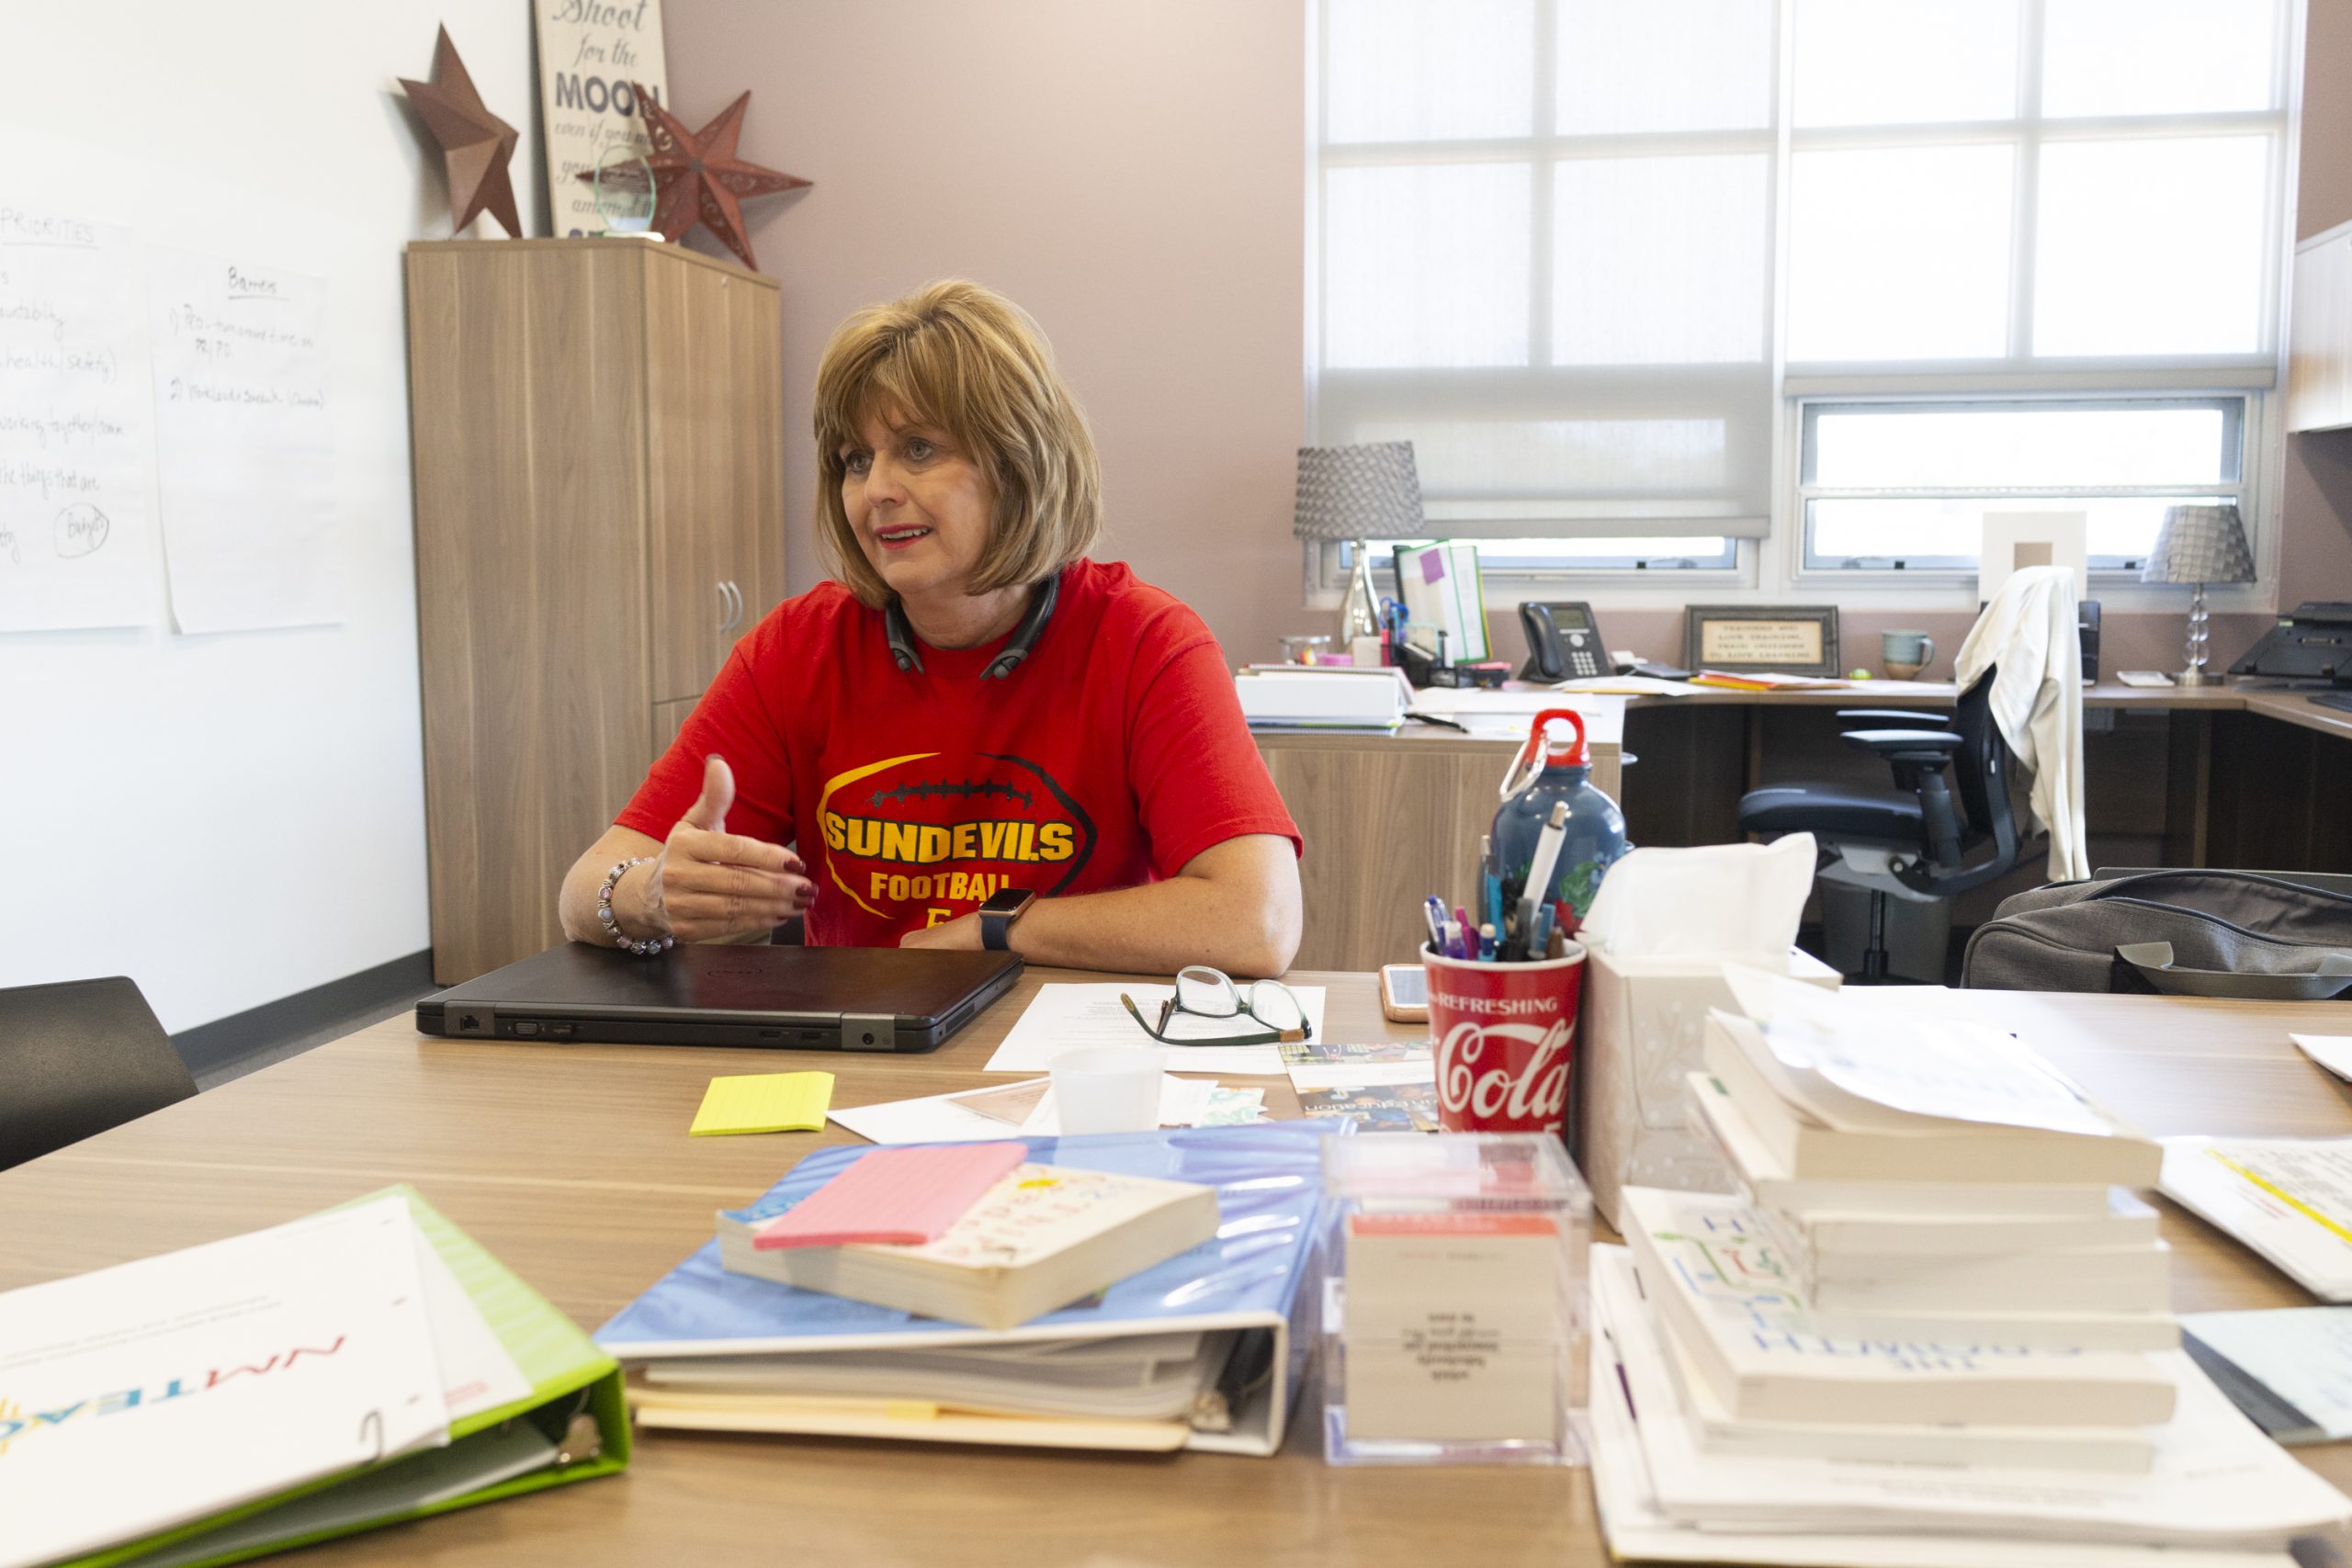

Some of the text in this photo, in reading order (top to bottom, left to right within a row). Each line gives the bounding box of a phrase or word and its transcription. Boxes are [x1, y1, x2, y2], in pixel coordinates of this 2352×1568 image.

[573, 33, 639, 68] for the
[824, 810, 1076, 864] SUNDEVILS
[1437, 992, 1558, 1017] REFRESHING
[1439, 1018, 1577, 1120] Cola
